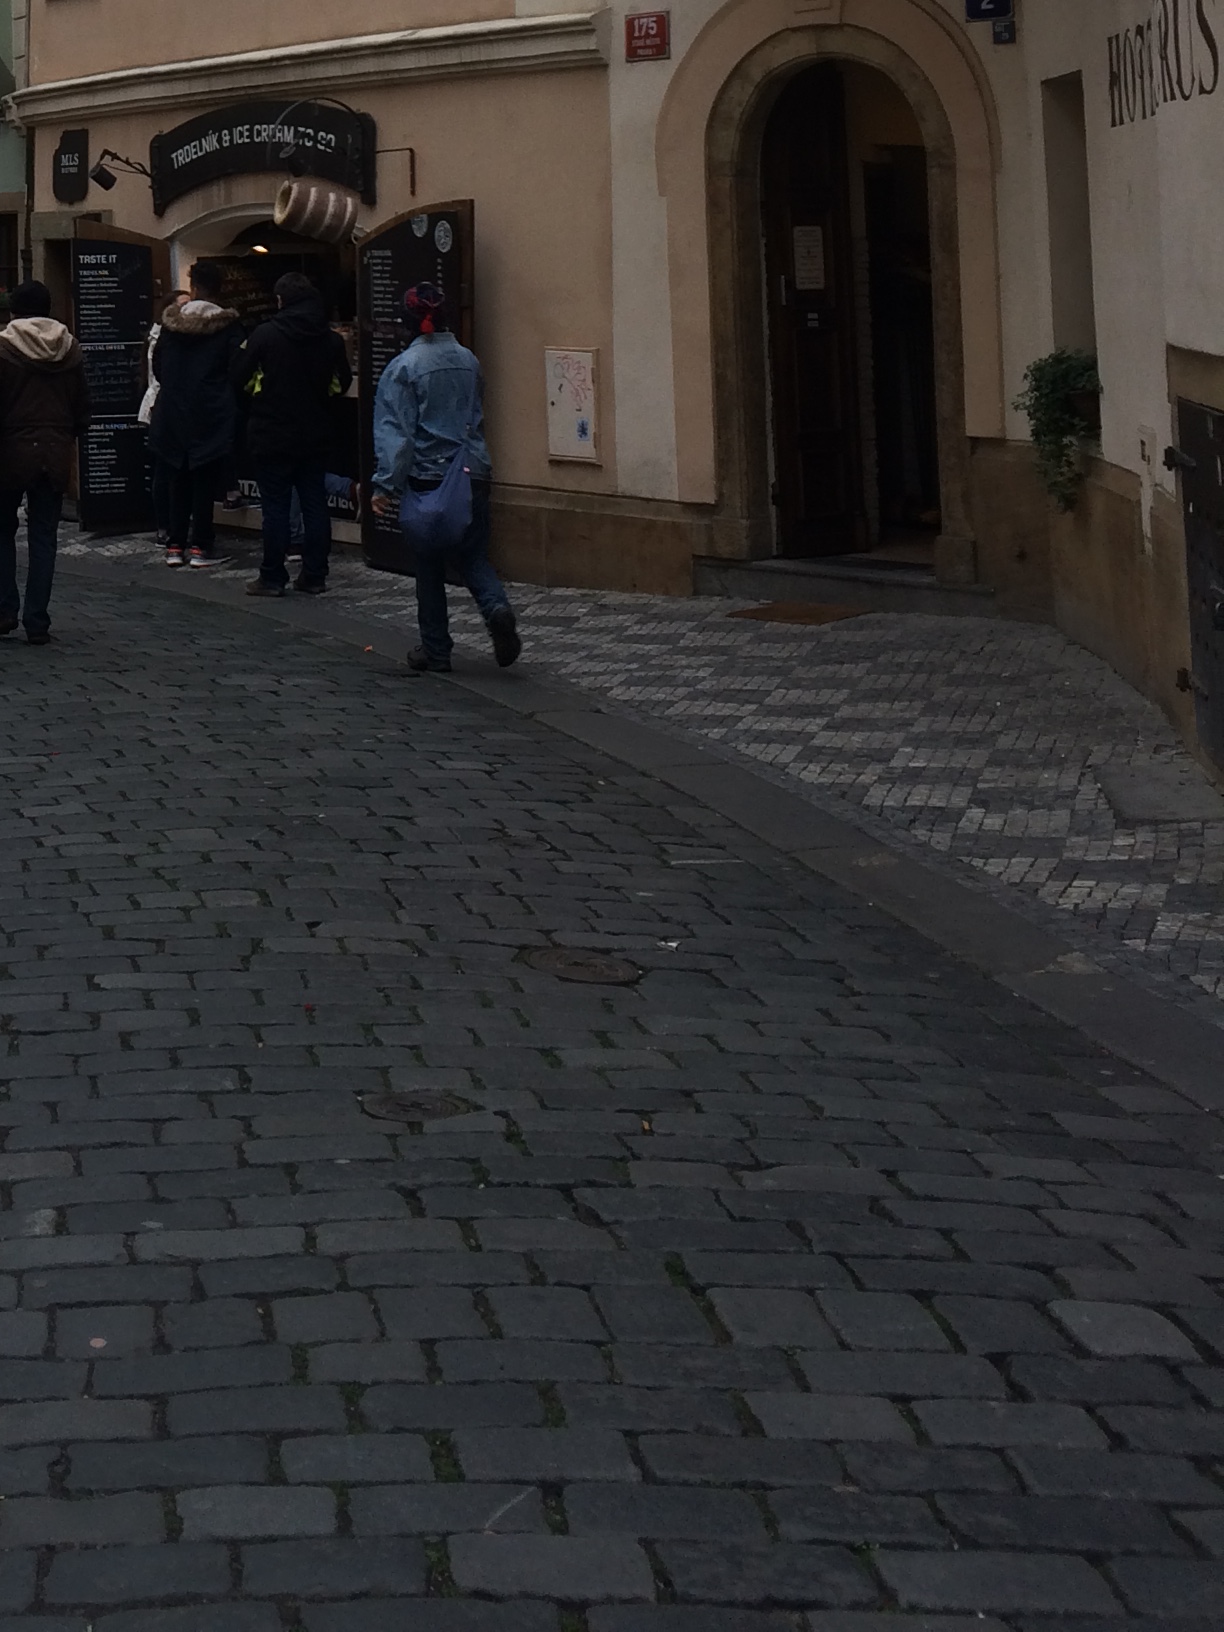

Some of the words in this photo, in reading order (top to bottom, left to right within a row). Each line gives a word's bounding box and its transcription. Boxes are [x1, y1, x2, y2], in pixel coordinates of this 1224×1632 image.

[633, 16, 657, 37] 175
[1107, 13, 1160, 128] HOTEL
[170, 130, 220, 169] TRDELNÍK
[221, 129, 231, 147] &
[233, 124, 251, 145] ICE
[253, 124, 295, 144] CREAM
[60, 153, 79, 166] MLS
[109, 254, 117, 264] IT
